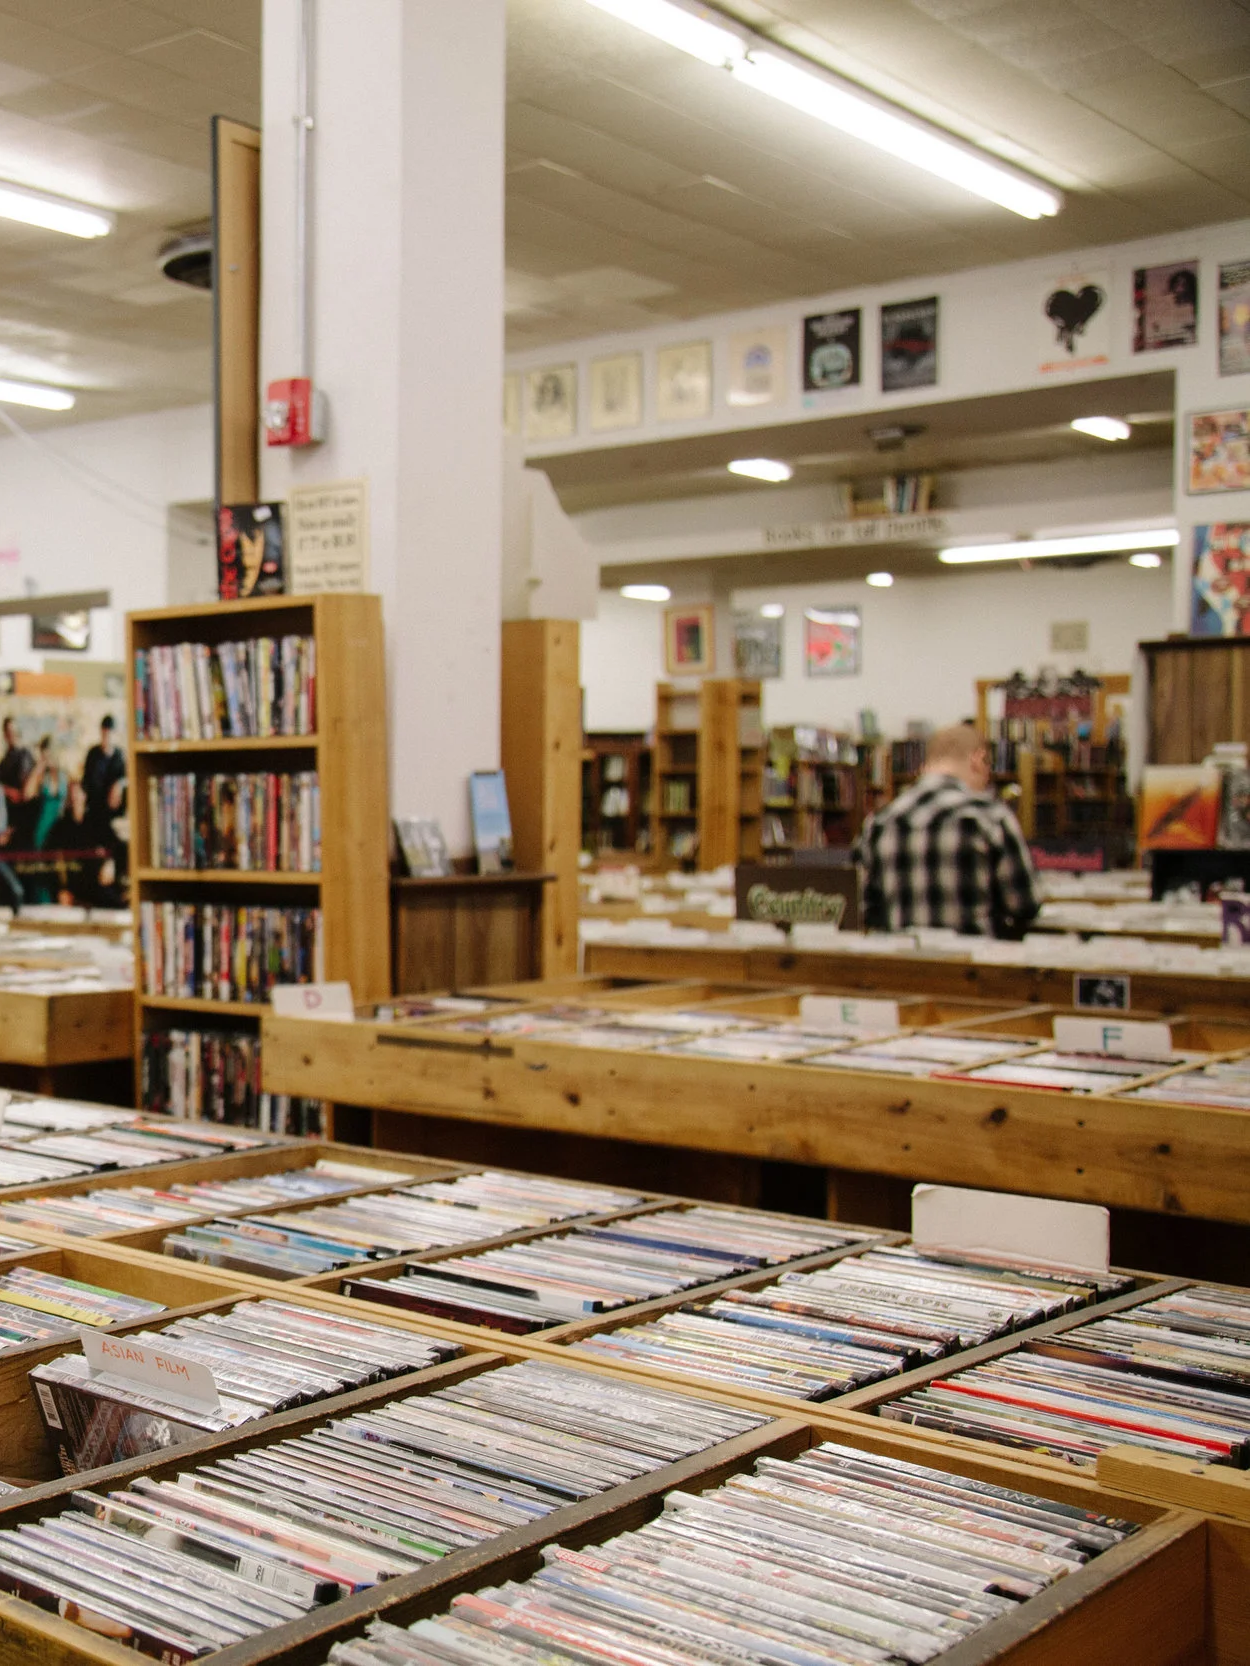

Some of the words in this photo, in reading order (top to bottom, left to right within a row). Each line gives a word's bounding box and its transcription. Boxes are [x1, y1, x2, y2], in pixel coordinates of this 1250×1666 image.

[304, 989, 322, 1010] D
[842, 1002, 858, 1024] E
[1102, 1027, 1124, 1051] F
[101, 1340, 145, 1363] ASIAN
[155, 1357, 191, 1381] FILM
